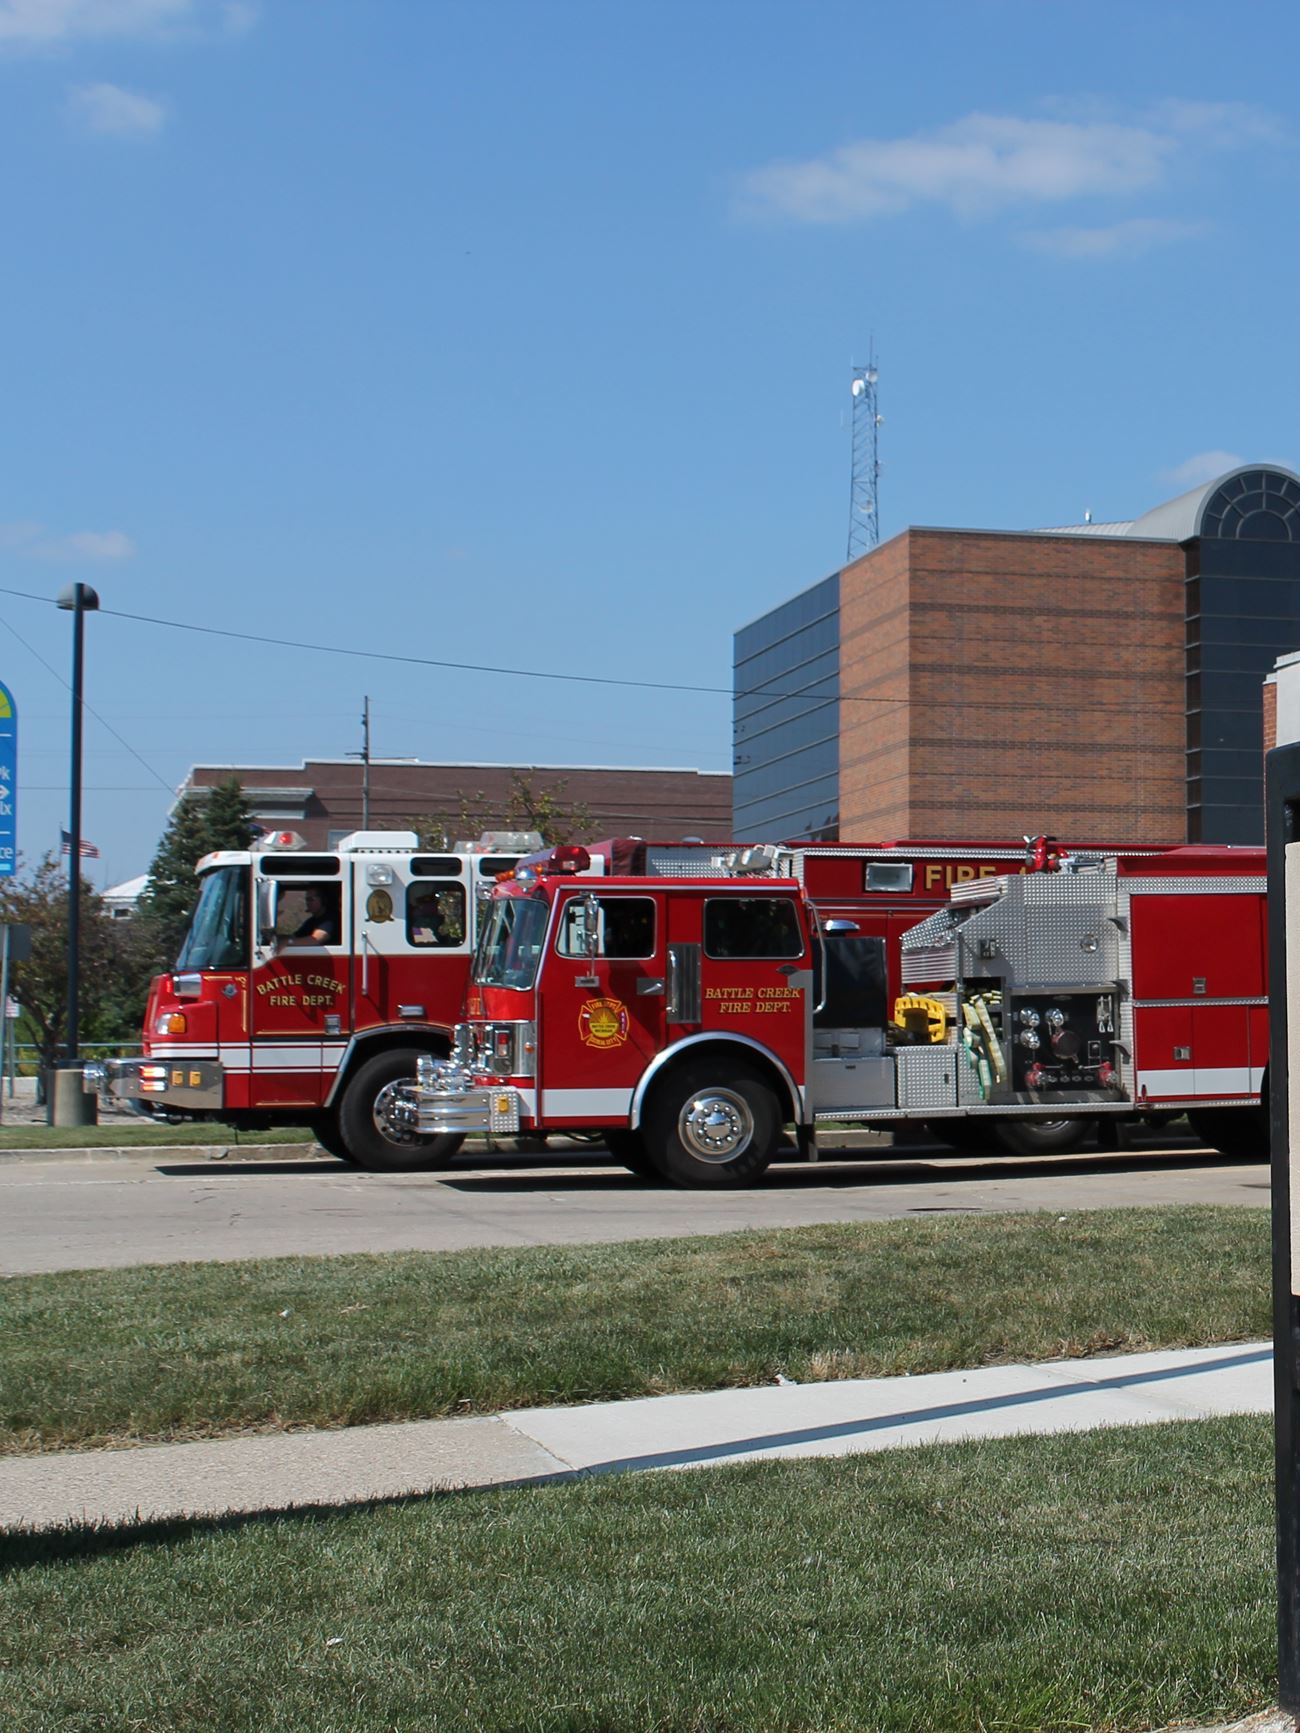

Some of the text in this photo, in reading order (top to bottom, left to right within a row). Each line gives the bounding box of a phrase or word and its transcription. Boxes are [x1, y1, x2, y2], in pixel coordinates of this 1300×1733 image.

[256, 974, 347, 995] BATTLE CREEK
[705, 987, 801, 999] BATTLE CREEK
[270, 995, 334, 1006] FIRE DEPT.
[720, 1002, 791, 1013] FIRE DEPT.
